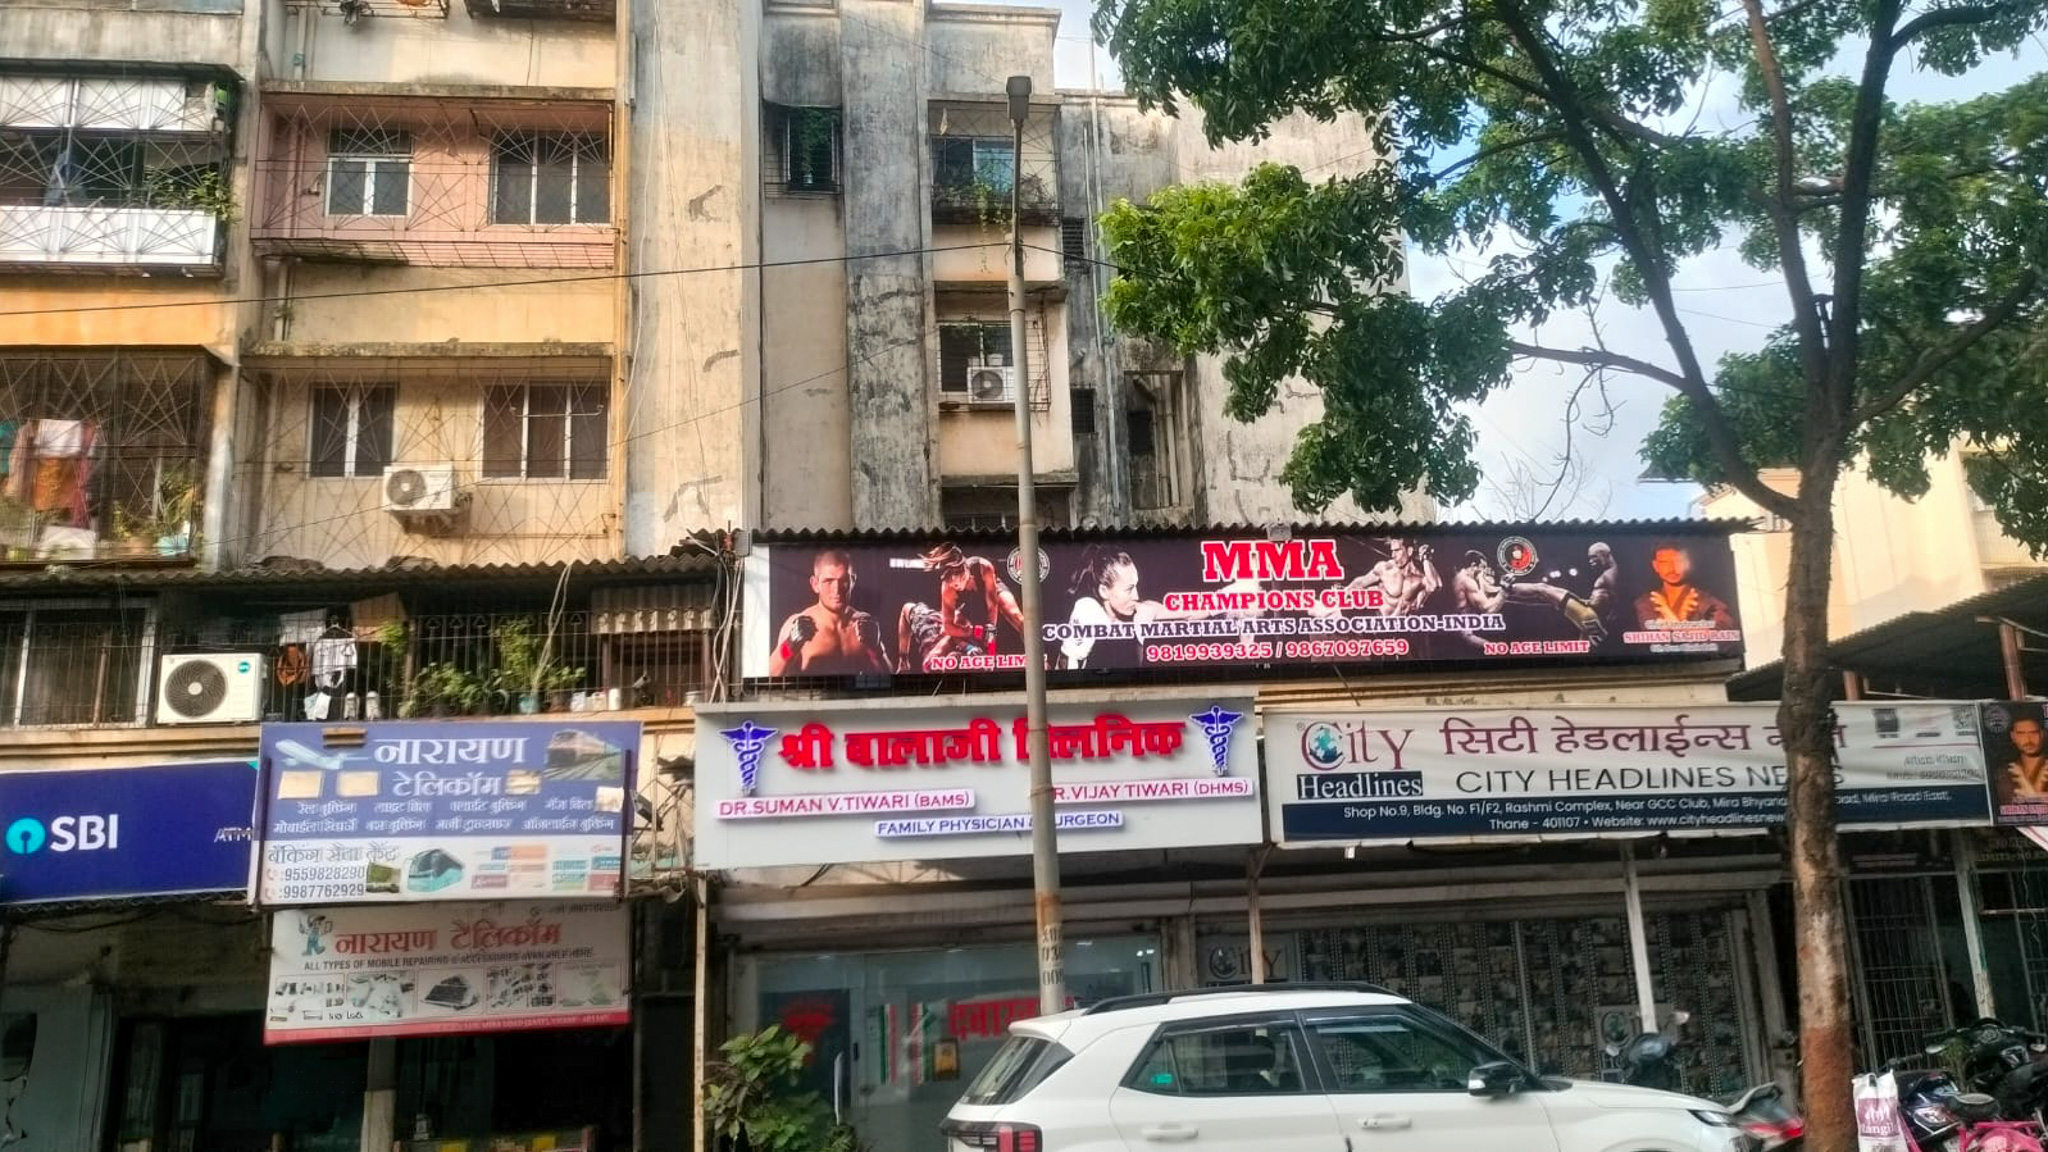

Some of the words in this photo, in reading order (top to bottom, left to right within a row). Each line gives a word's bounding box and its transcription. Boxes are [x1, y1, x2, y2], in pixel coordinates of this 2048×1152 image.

[1202, 540, 1344, 582] MMA
[1164, 589, 1314, 612] CHAMPIONS
[1320, 588, 1384, 609] CLUB
[1042, 622, 1136, 641] COMBAT
[1140, 620, 1238, 639] MARTIAL
[1241, 618, 1295, 637] ARTS
[1297, 614, 1506, 635] ASSOCIATION-INDIA
[1147, 642, 1273, 662] 9819939325
[1286, 639, 1409, 658] 9867097659
[1484, 642, 1508, 655] NO
[1510, 641, 1542, 654] AGE
[1544, 640, 1589, 653] LIMIT
[930, 656, 957, 670] NO
[959, 655, 995, 670] AGE
[778, 723, 834, 768] श्री
[844, 717, 1001, 766] बालाजी
[1439, 716, 1539, 756] सिटी
[1551, 714, 1752, 758] हेडलाईन्स
[373, 737, 531, 765] नारायण
[392, 770, 502, 797] टेलिकॉम
[1053, 784, 1120, 801] R.VIJAY
[1124, 783, 1189, 798] TIWARI
[1194, 780, 1248, 796] (DHMS)
[1300, 773, 1423, 800] Headlines
[1456, 770, 1535, 793] CITY
[1549, 766, 1736, 791] HEADLINES
[1746, 765, 1844, 787] NES
[914, 791, 970, 808] (BAMS)
[1343, 807, 1376, 820] Shop
[1413, 804, 1444, 818] Bldg.
[1447, 803, 1467, 815] No.
[1505, 801, 1552, 813] Rashmi
[1555, 799, 1614, 814] Complex,
[1615, 799, 1645, 811] Near
[1647, 798, 1676, 810] GCC
[1678, 798, 1711, 811] Club,
[878, 820, 934, 835] FAMILY
[938, 817, 1025, 832] PHYSICIAN
[1055, 813, 1120, 827] URGEON
[1489, 819, 1529, 830] Thane
[1541, 817, 1581, 829] 401107
[50, 814, 118, 851] SBI
[214, 827, 252, 843] ATM
[333, 929, 438, 955] नारायण
[304, 960, 320, 971] ALL
[323, 959, 351, 970] TYPES
[353, 958, 365, 969] OF
[367, 957, 403, 968] MOBILE
